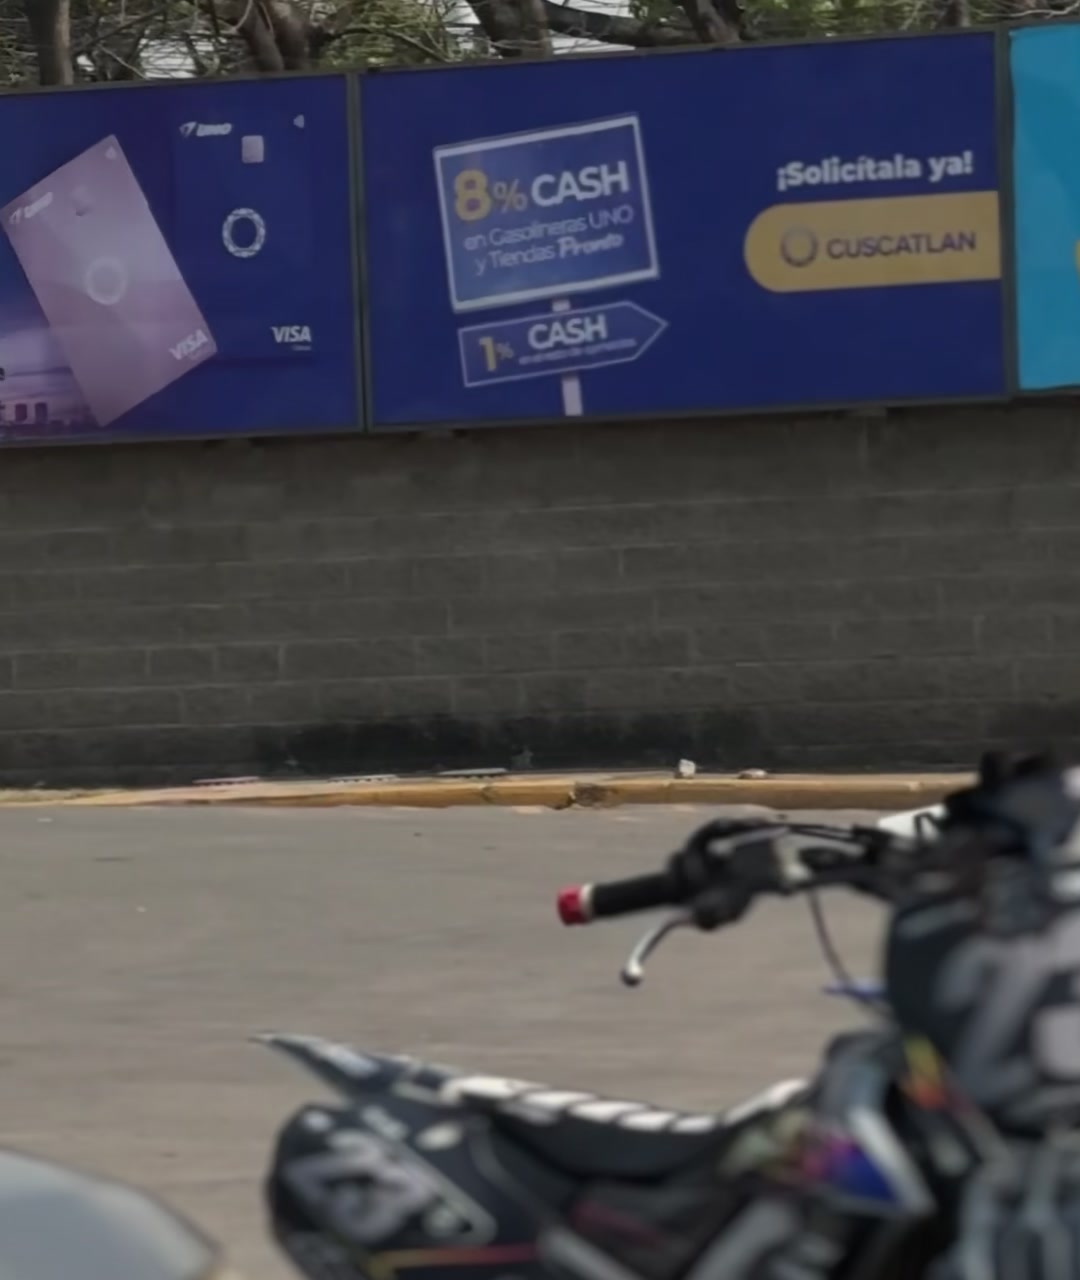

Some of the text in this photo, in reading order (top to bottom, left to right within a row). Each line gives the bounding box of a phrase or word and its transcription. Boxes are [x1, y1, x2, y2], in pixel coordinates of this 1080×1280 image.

[531, 160, 630, 207] CASH
[777, 150, 974, 191] ¡Solicítala ya!
[463, 204, 635, 251] en Gasolineras UNO
[826, 232, 976, 260] CUSCATLAN
[474, 233, 624, 276] y Tiendas Pronto
[168, 329, 209, 360] VISA
[270, 325, 312, 343] VISA
[527, 315, 608, 349] CASH
